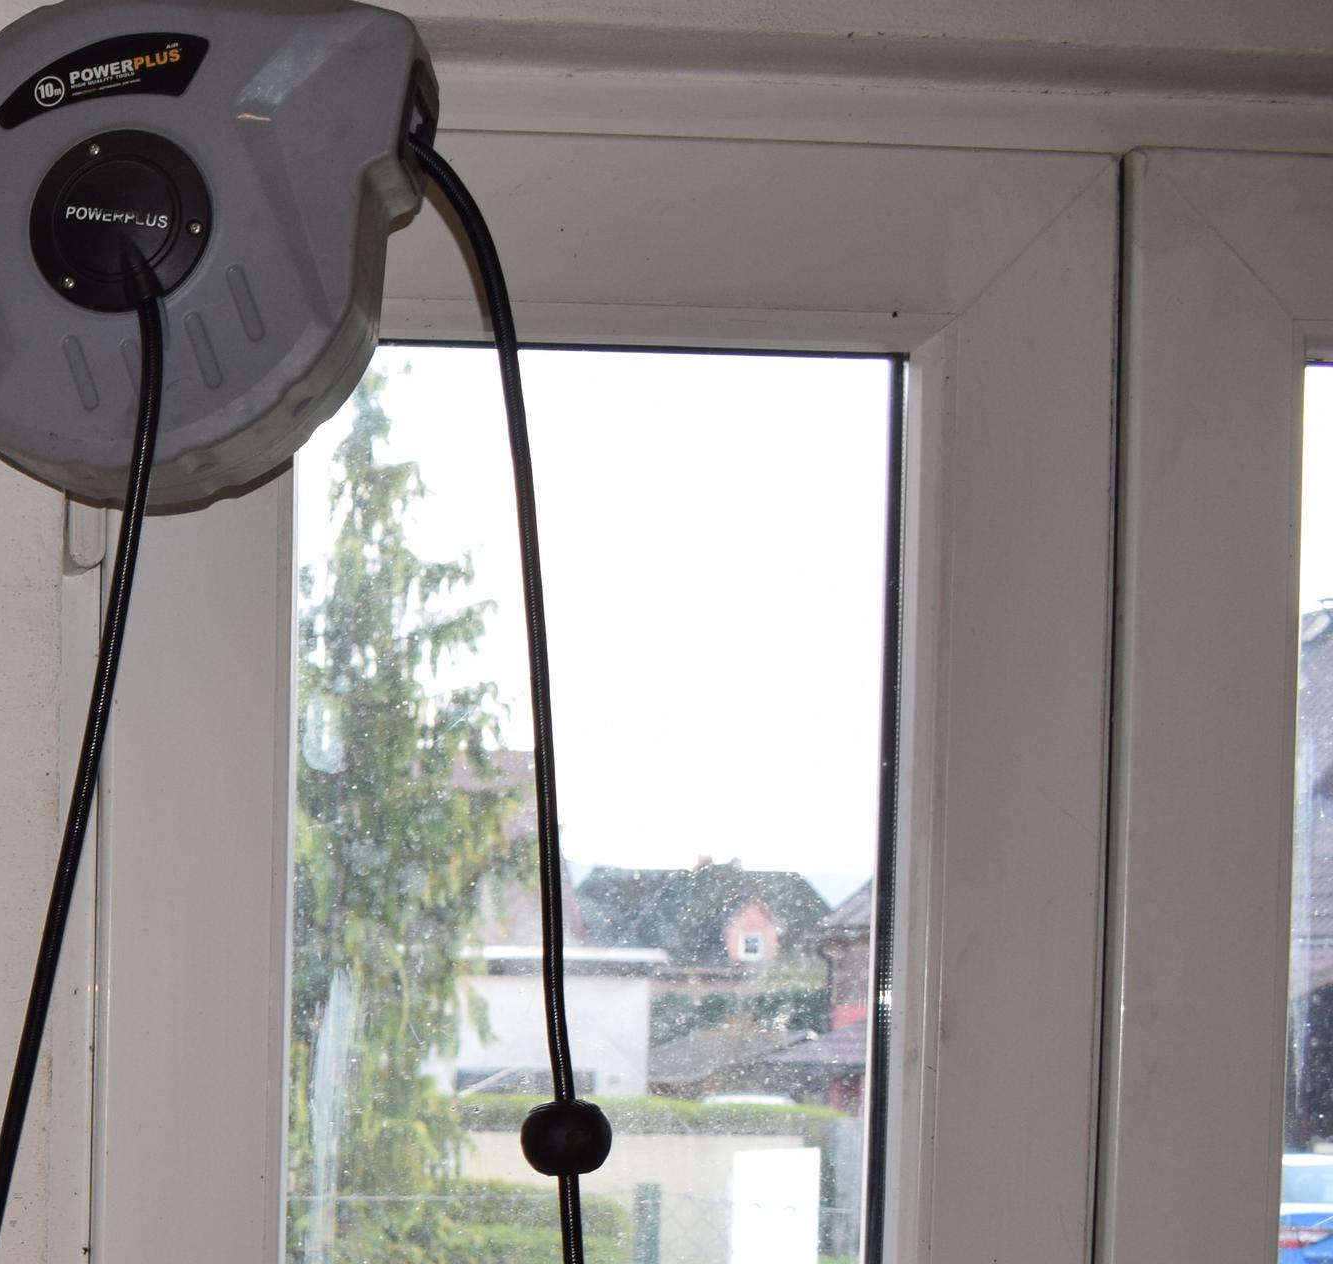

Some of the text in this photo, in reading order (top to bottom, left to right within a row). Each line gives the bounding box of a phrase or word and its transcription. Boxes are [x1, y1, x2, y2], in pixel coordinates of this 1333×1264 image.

[69, 49, 181, 84] POWERPLUS
[38, 82, 62, 99] 10m
[65, 206, 168, 229] POWERPLUS
